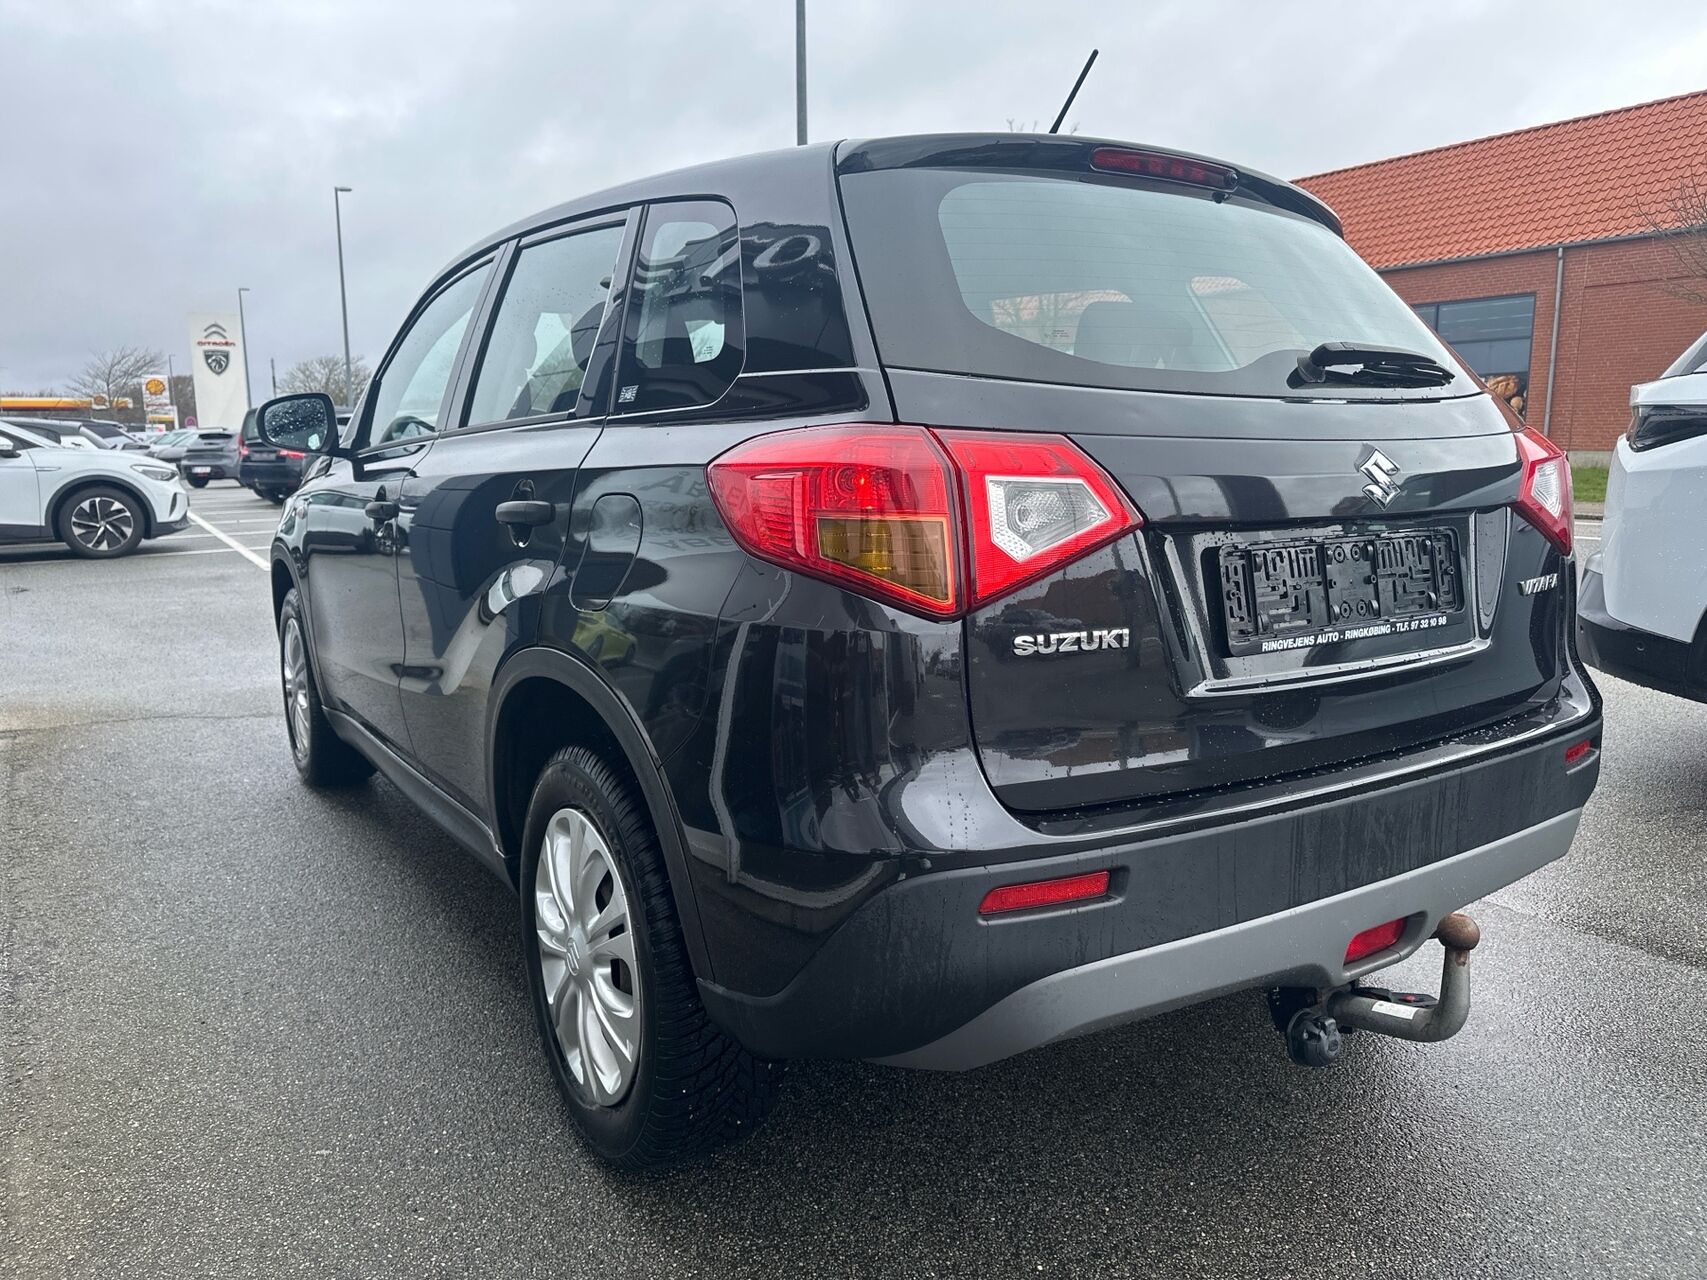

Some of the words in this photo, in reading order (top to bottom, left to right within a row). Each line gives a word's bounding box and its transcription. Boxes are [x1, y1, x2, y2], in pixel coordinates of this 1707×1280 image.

[1013, 628, 1130, 656] SUZUKI
[1262, 635, 1315, 652] RINGVEJENS
[1316, 631, 1339, 645] AUTO
[1344, 624, 1391, 640] RINGKØBING
[1396, 621, 1410, 632] TLF.
[1410, 620, 1419, 630] 97
[1419, 618, 1429, 629] 32
[1430, 617, 1438, 627] 10
[1438, 615, 1447, 626] 98
